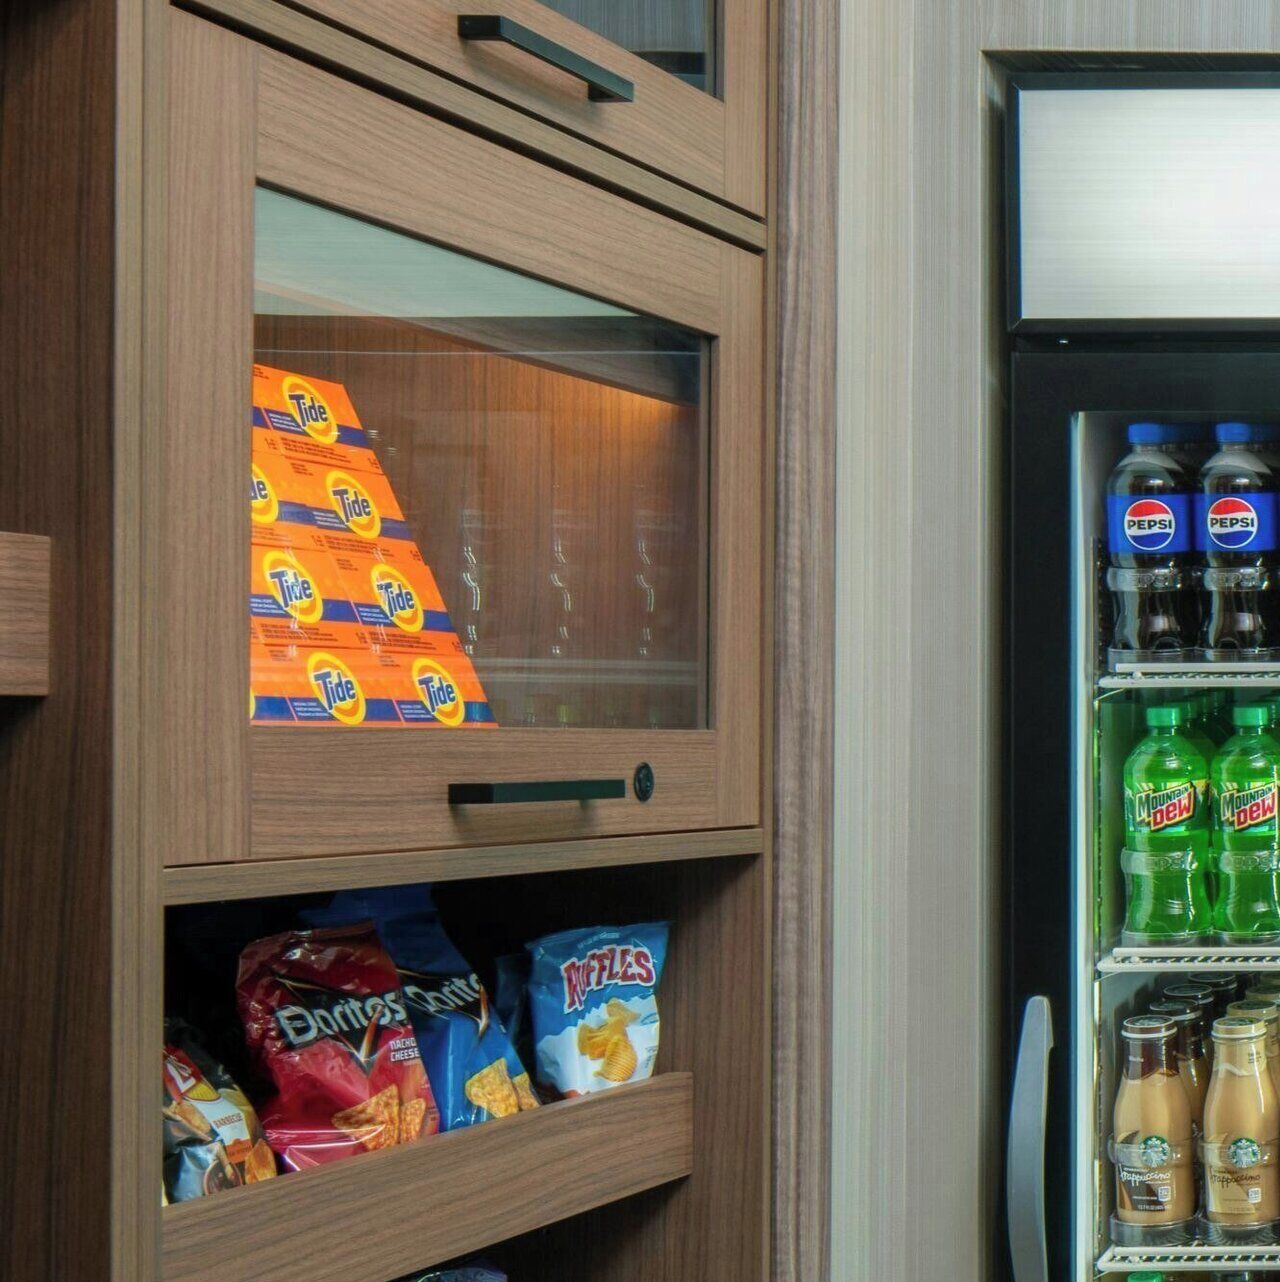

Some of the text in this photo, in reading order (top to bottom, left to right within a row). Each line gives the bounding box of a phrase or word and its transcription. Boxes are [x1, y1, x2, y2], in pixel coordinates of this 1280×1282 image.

[289, 393, 328, 427] Tide
[332, 488, 371, 523] Tide
[1210, 517, 1254, 529] PEPSI
[1127, 518, 1172, 531] PEPSI
[270, 570, 313, 608] Tide
[377, 581, 415, 618] Tide
[314, 670, 357, 712] Tide
[417, 675, 456, 713] Tide
[562, 945, 655, 1013] RUFFLES
[276, 991, 408, 1046] Doritos
